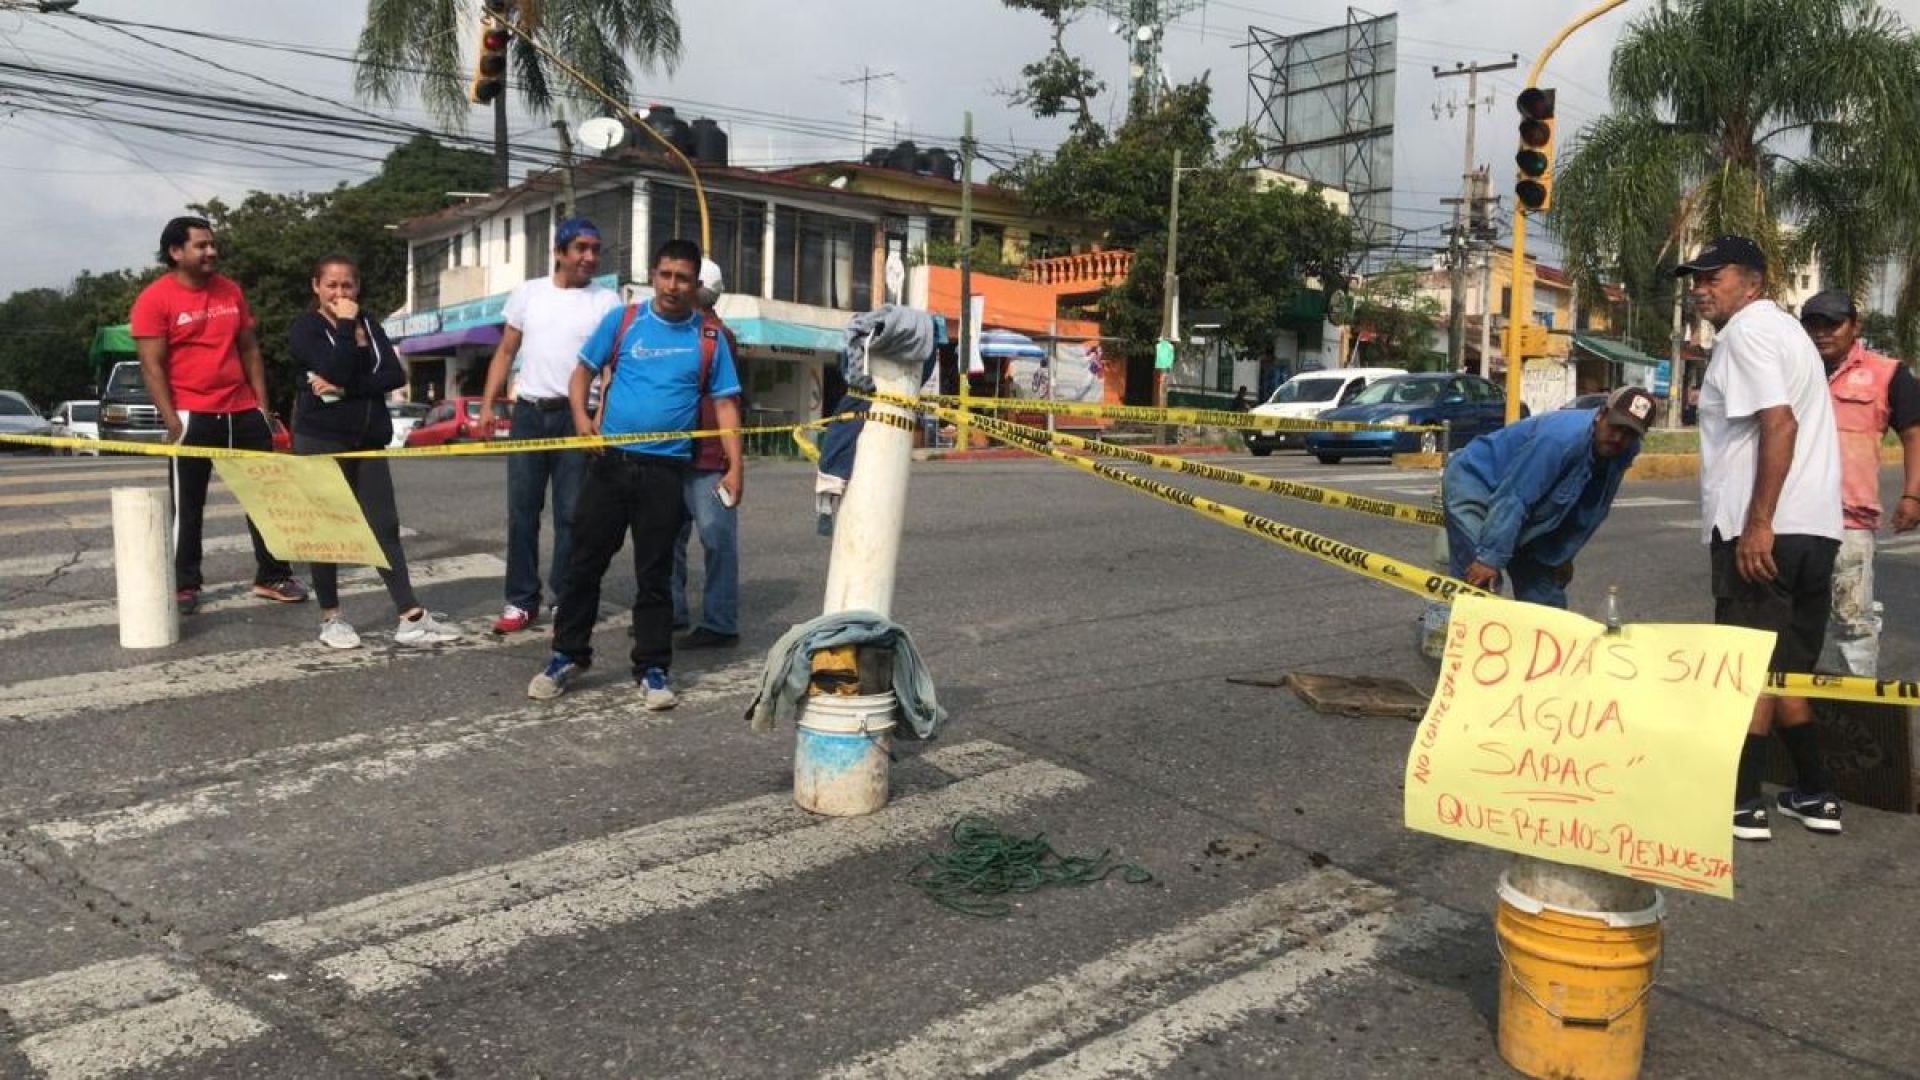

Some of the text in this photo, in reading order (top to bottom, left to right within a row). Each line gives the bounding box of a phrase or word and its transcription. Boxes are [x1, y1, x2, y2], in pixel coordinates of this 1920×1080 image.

[1181, 461, 1245, 485] PRECAUCION
[1269, 480, 1324, 503] PRECAUCION
[1346, 496, 1396, 517] PRECAUCION
[1472, 621, 1748, 694] 8 DIAS SIN
[1489, 694, 1625, 744] AGUA
[1412, 754, 1432, 785] NO
